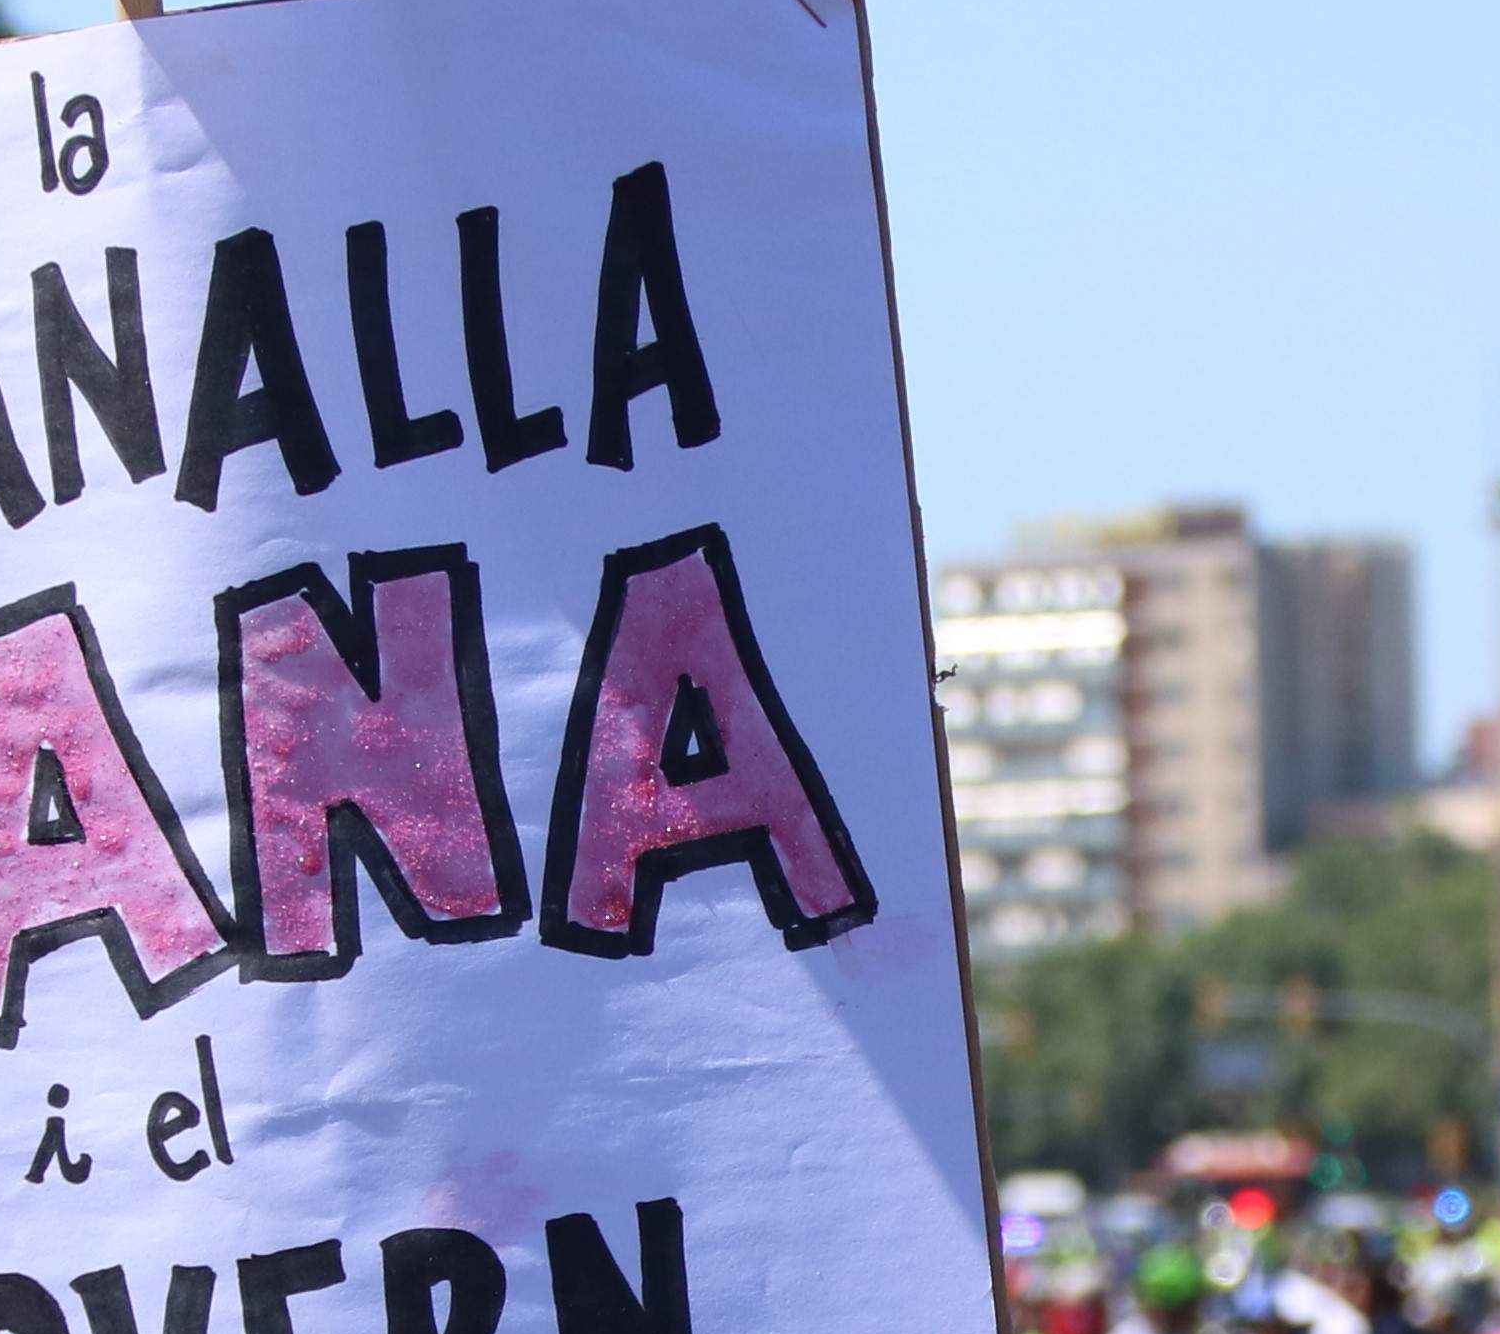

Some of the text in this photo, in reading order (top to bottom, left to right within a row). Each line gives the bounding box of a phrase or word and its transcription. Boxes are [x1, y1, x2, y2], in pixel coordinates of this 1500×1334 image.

[30, 70, 109, 196] la
[25, 1034, 235, 1185] i el
